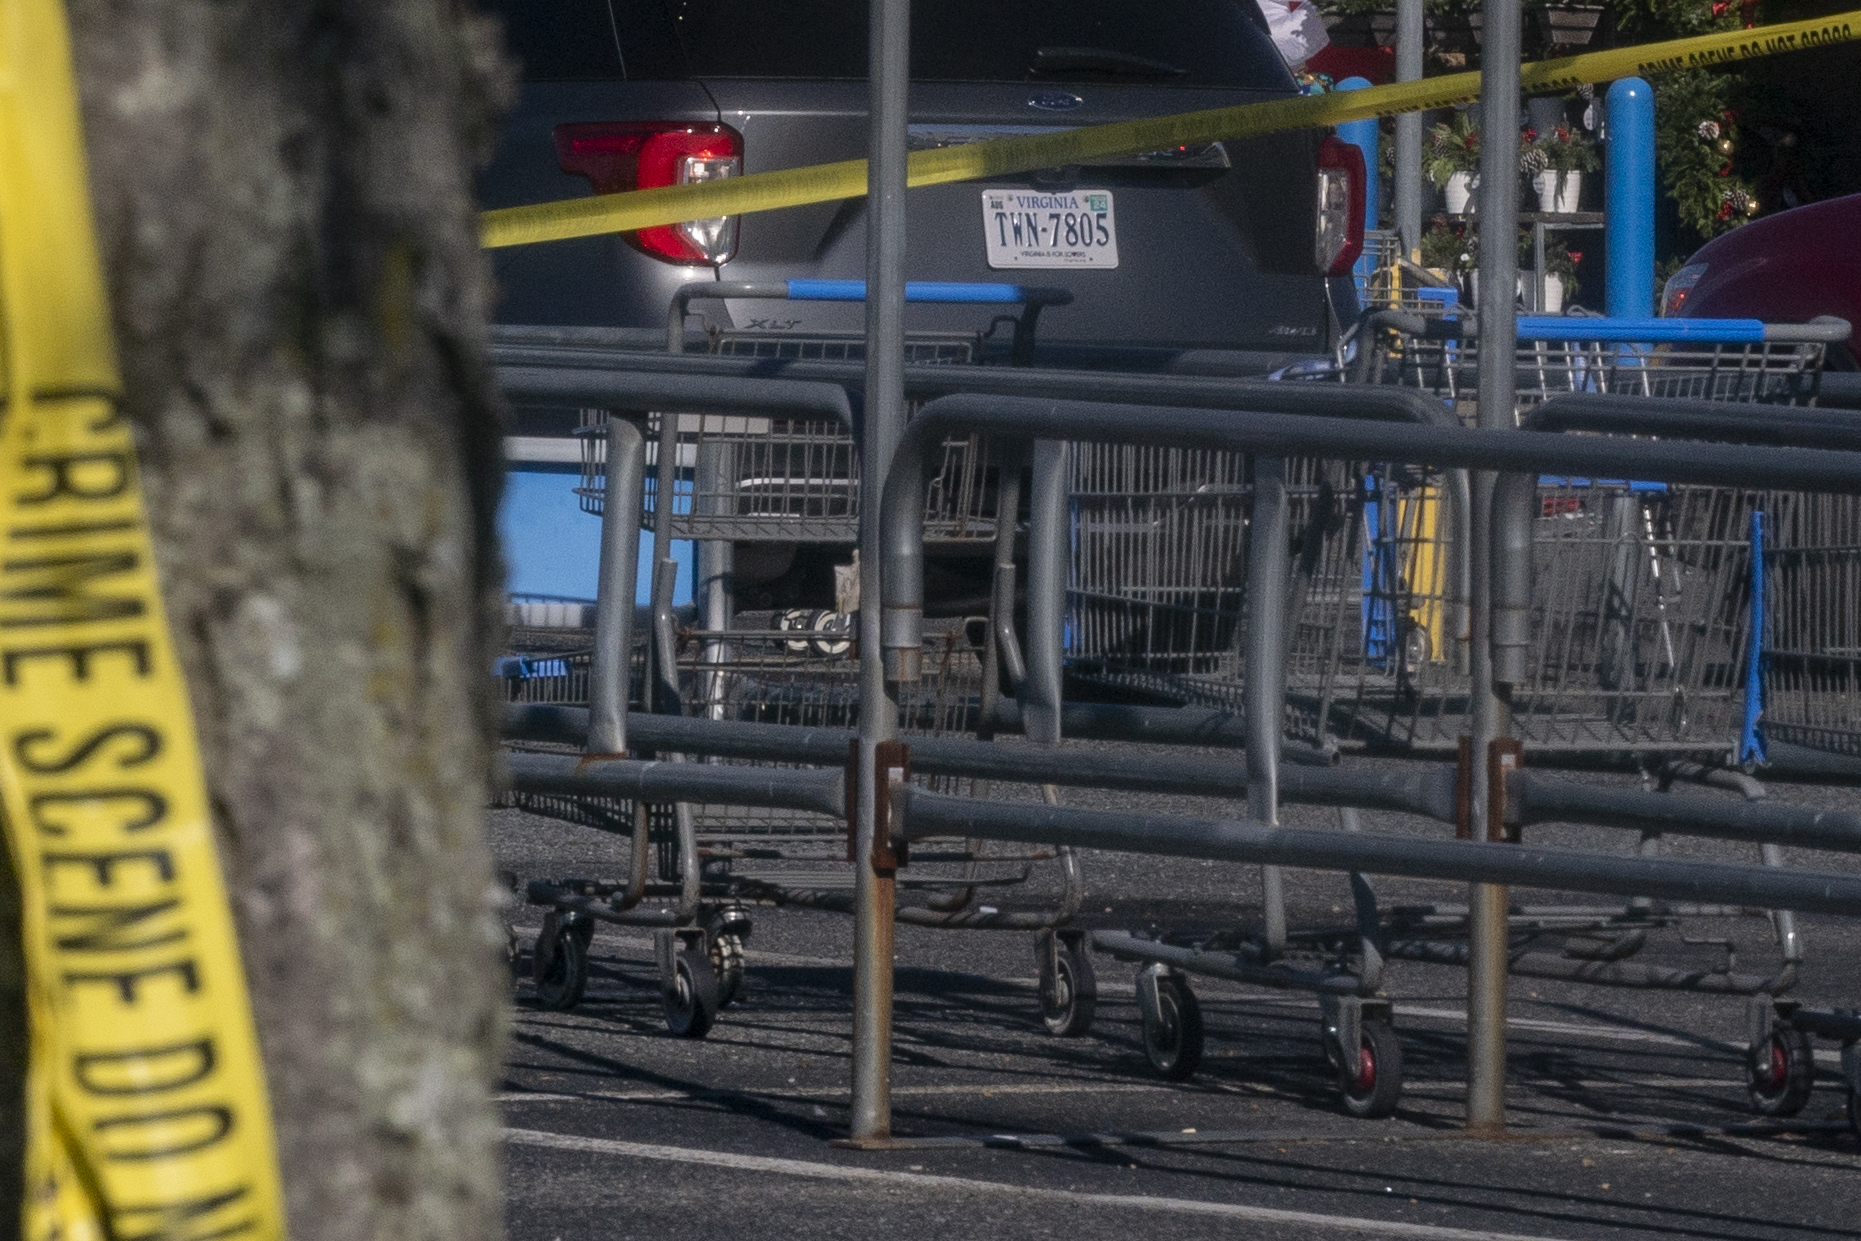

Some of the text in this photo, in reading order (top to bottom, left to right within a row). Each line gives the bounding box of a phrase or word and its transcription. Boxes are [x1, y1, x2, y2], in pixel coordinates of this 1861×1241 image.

[995, 212, 1109, 247] TWN-7805
[1017, 196, 1080, 209] VIRGINIA
[9, 723, 201, 1013] SCENE
[72, 1038, 237, 1163] DO
